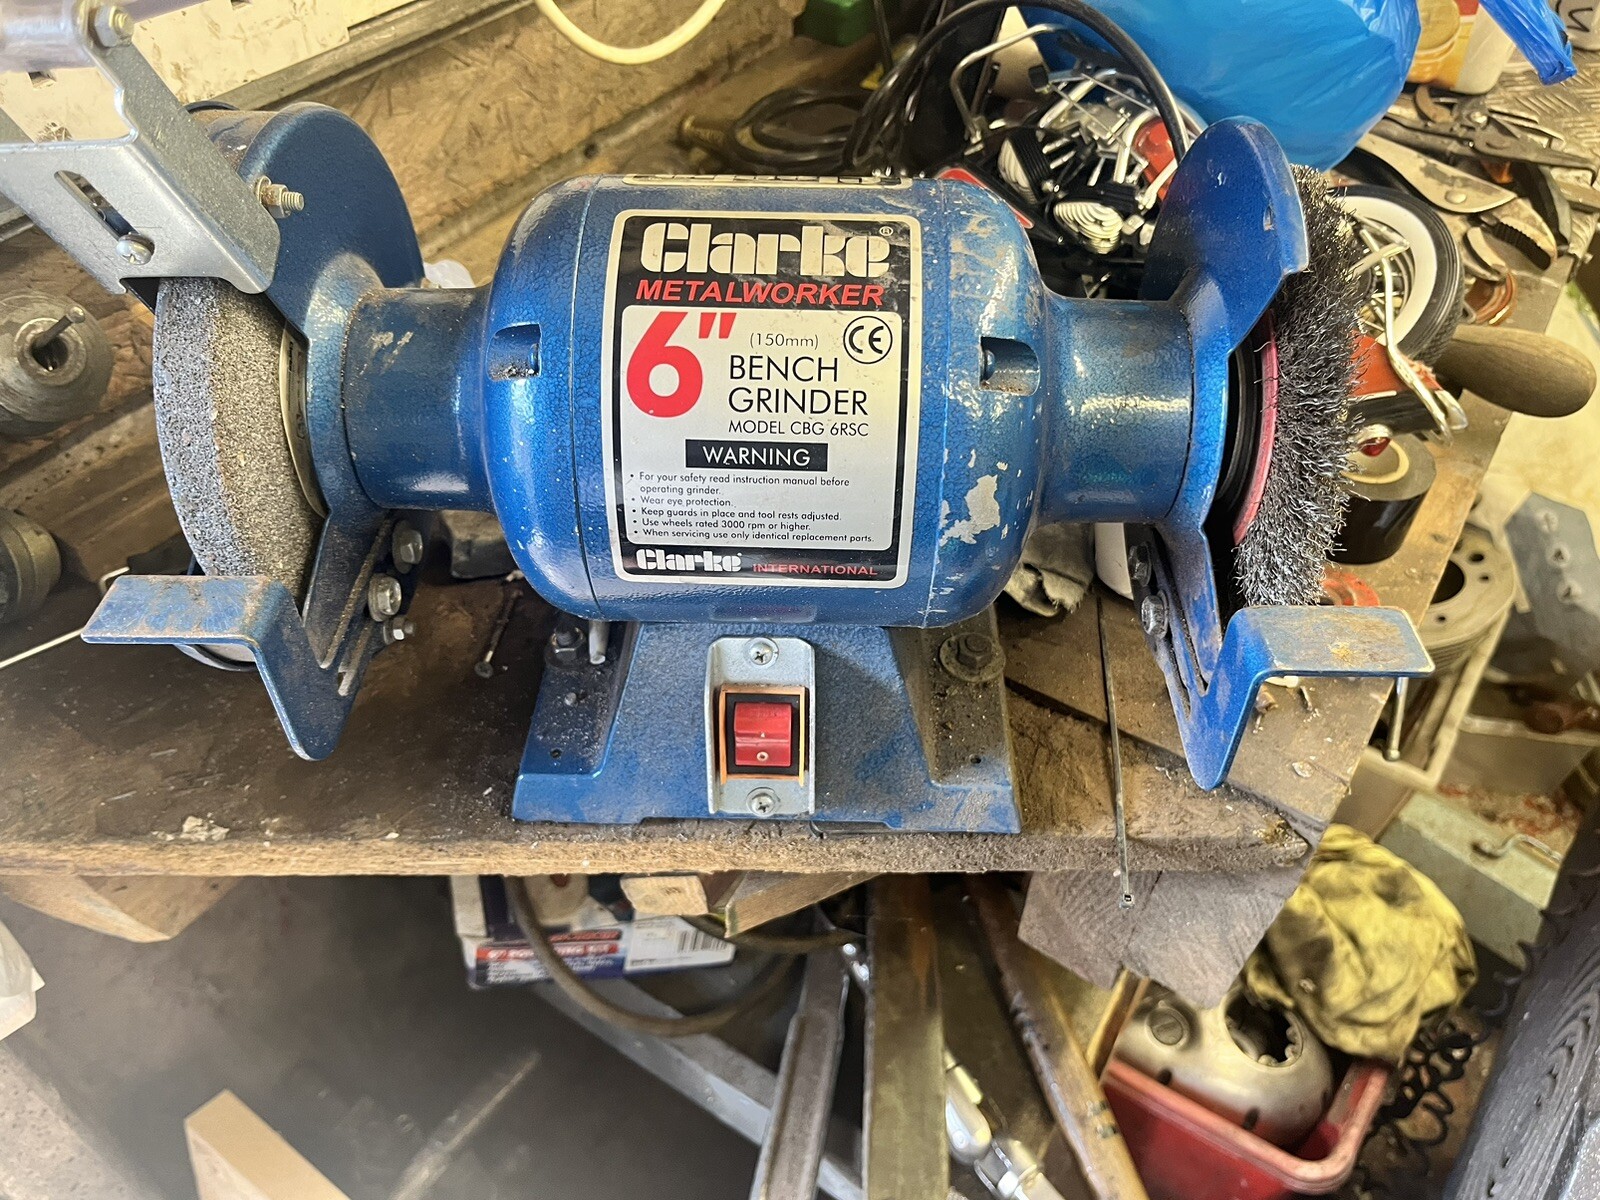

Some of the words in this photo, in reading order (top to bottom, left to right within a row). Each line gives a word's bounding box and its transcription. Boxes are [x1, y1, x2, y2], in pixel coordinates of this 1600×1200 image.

[636, 279, 884, 306] METALWORKER
[750, 332, 819, 350] (150mm)
[730, 355, 838, 382] BENCH
[728, 387, 868, 415] GRINDER
[728, 420, 785, 435] MODEL
[790, 421, 825, 436] CBG
[830, 422, 869, 437] 6RSC
[702, 446, 811, 467] WARNING
[639, 471, 654, 480] For
[657, 474, 677, 483] your
[680, 473, 706, 484] safety
[709, 474, 730, 483] read
[733, 474, 780, 484] instruction
[782, 476, 818, 486] manual
[820, 477, 850, 486] before
[640, 485, 684, 495] operating
[686, 486, 721, 496] grinder.
[640, 495, 664, 504] Wear
[667, 498, 683, 507] eye
[686, 497, 734, 507] protection.
[641, 507, 664, 516] Keep
[667, 508, 698, 517] guards
[700, 508, 709, 517] in
[711, 509, 736, 518] place
[738, 510, 756, 518] and
[758, 511, 776, 519] tool
[778, 511, 799, 520] rests
[801, 512, 842, 521] adjusted.
[642, 518, 659, 526] Use
[662, 519, 693, 527] wheels
[695, 520, 719, 528] rated
[721, 520, 745, 529] 3000
[748, 522, 765, 531] rpm
[768, 522, 778, 530] or
[780, 521, 811, 532] higher.
[642, 528, 669, 537] When
[671, 529, 710, 539] servicing
[712, 531, 728, 539] use
[730, 531, 750, 540] only
[752, 532, 790, 541] identical
[792, 533, 847, 543] replacement
[849, 535, 875, 543] parts.
[636, 549, 741, 572] Clarke
[753, 563, 878, 576] INTERNATIONAL
